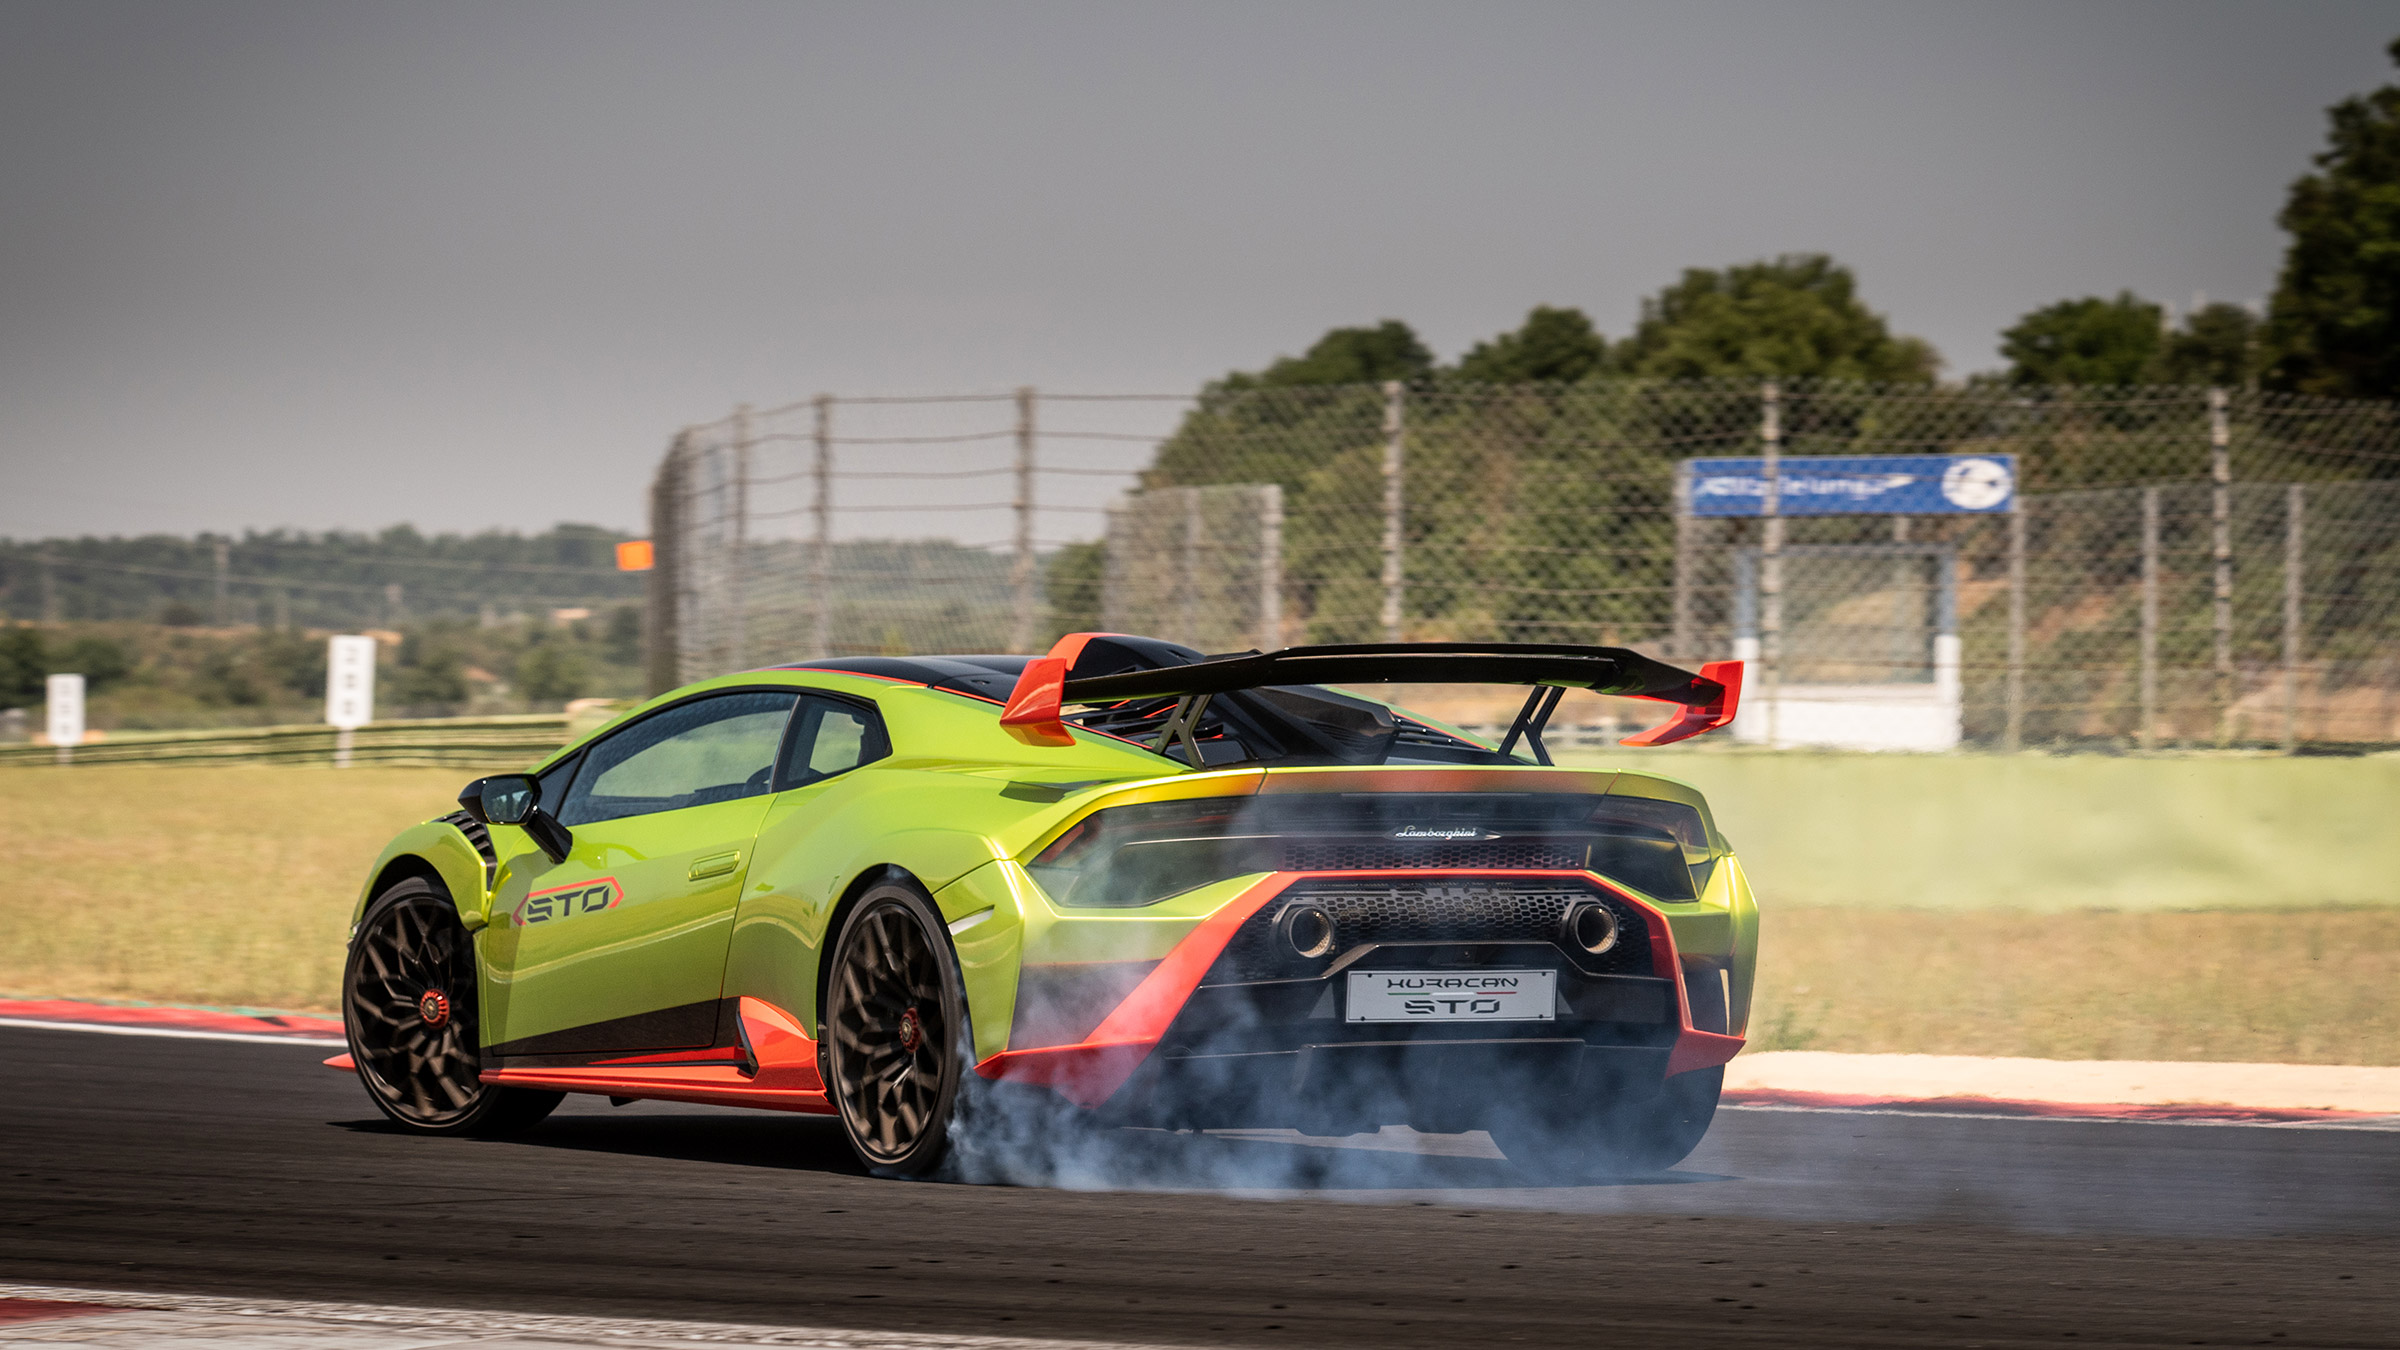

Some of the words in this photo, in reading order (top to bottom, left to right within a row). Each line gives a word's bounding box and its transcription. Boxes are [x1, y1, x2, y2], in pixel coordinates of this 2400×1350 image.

[1396, 825, 1477, 840] Lamborghini
[527, 885, 609, 923] STO
[1405, 999, 1500, 1014] STO
